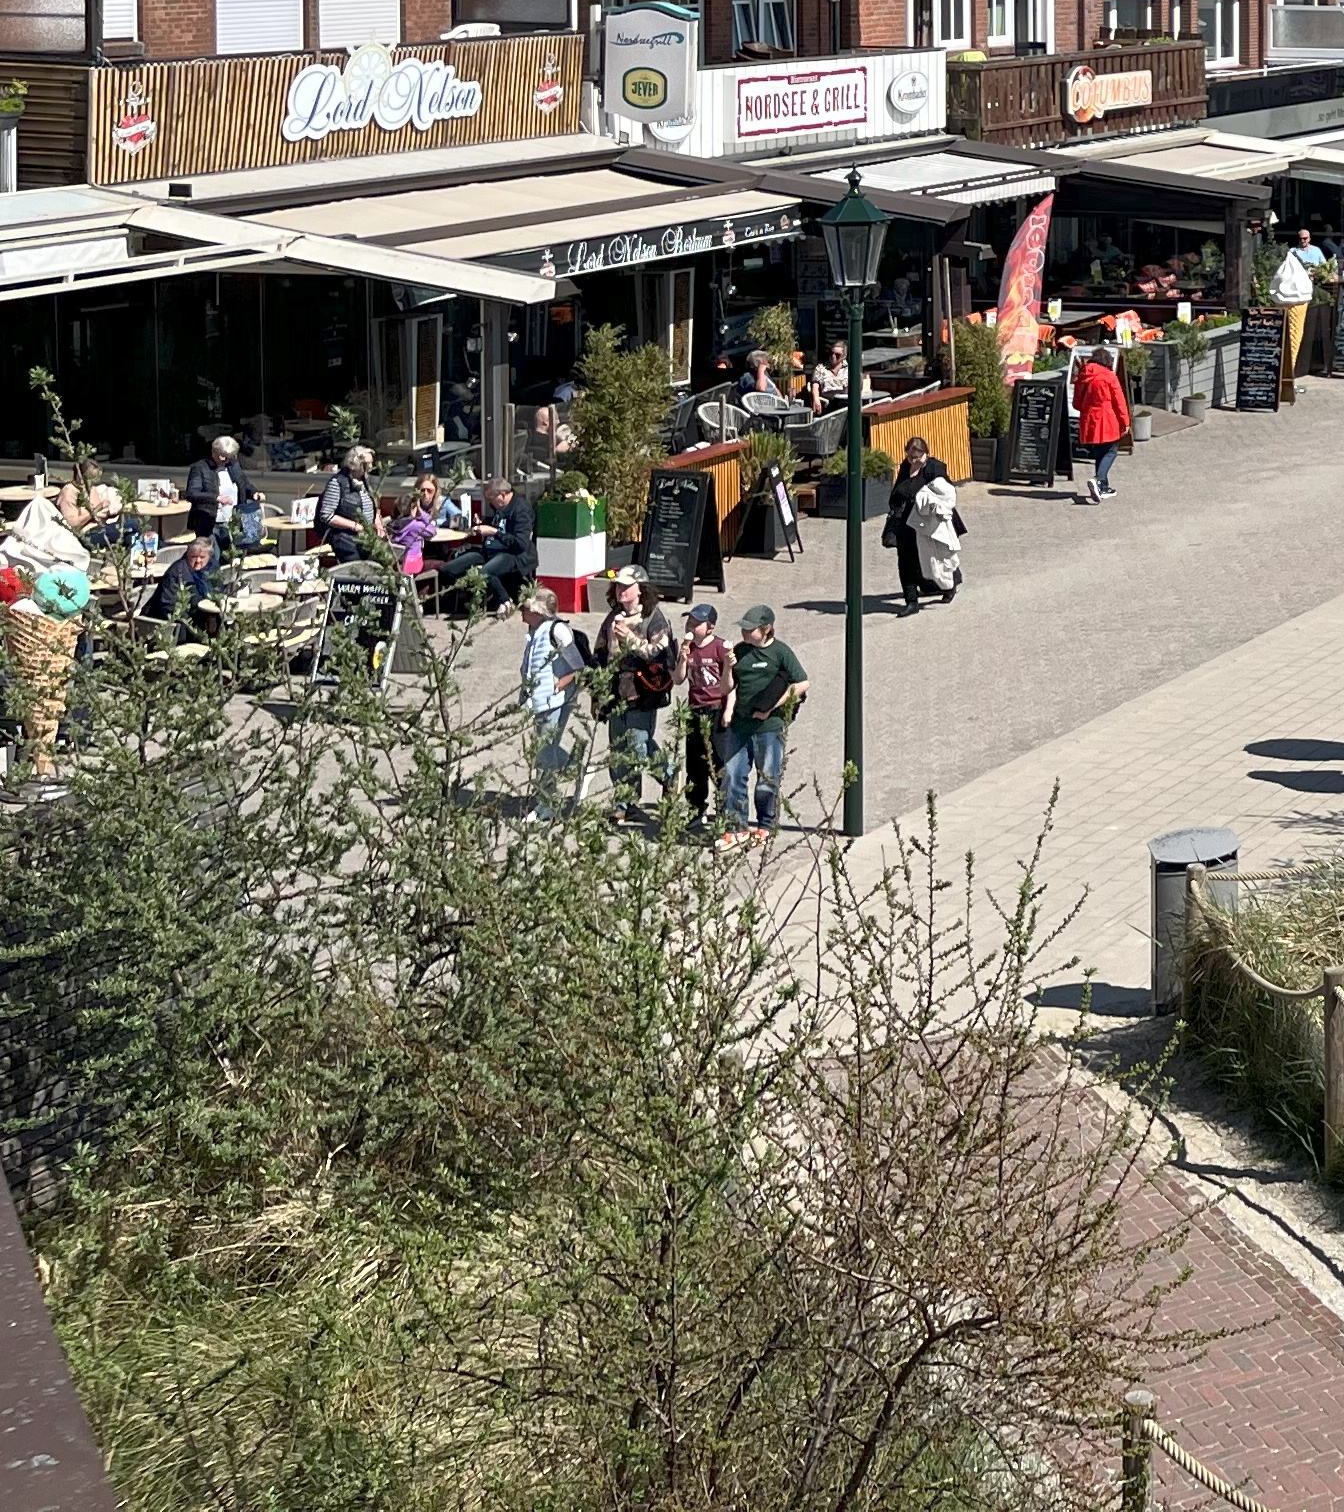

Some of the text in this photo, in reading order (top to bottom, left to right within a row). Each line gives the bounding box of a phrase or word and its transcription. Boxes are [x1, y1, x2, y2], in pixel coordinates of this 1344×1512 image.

[288, 64, 479, 133] Lord Nelson
[631, 81, 660, 98] JEVER
[745, 83, 861, 122] NORDSEE & GRILL
[1072, 74, 1150, 113] COLUMBUS
[566, 241, 604, 273] Lord
[608, 233, 658, 265] Nelson
[661, 226, 713, 255] Borkum
